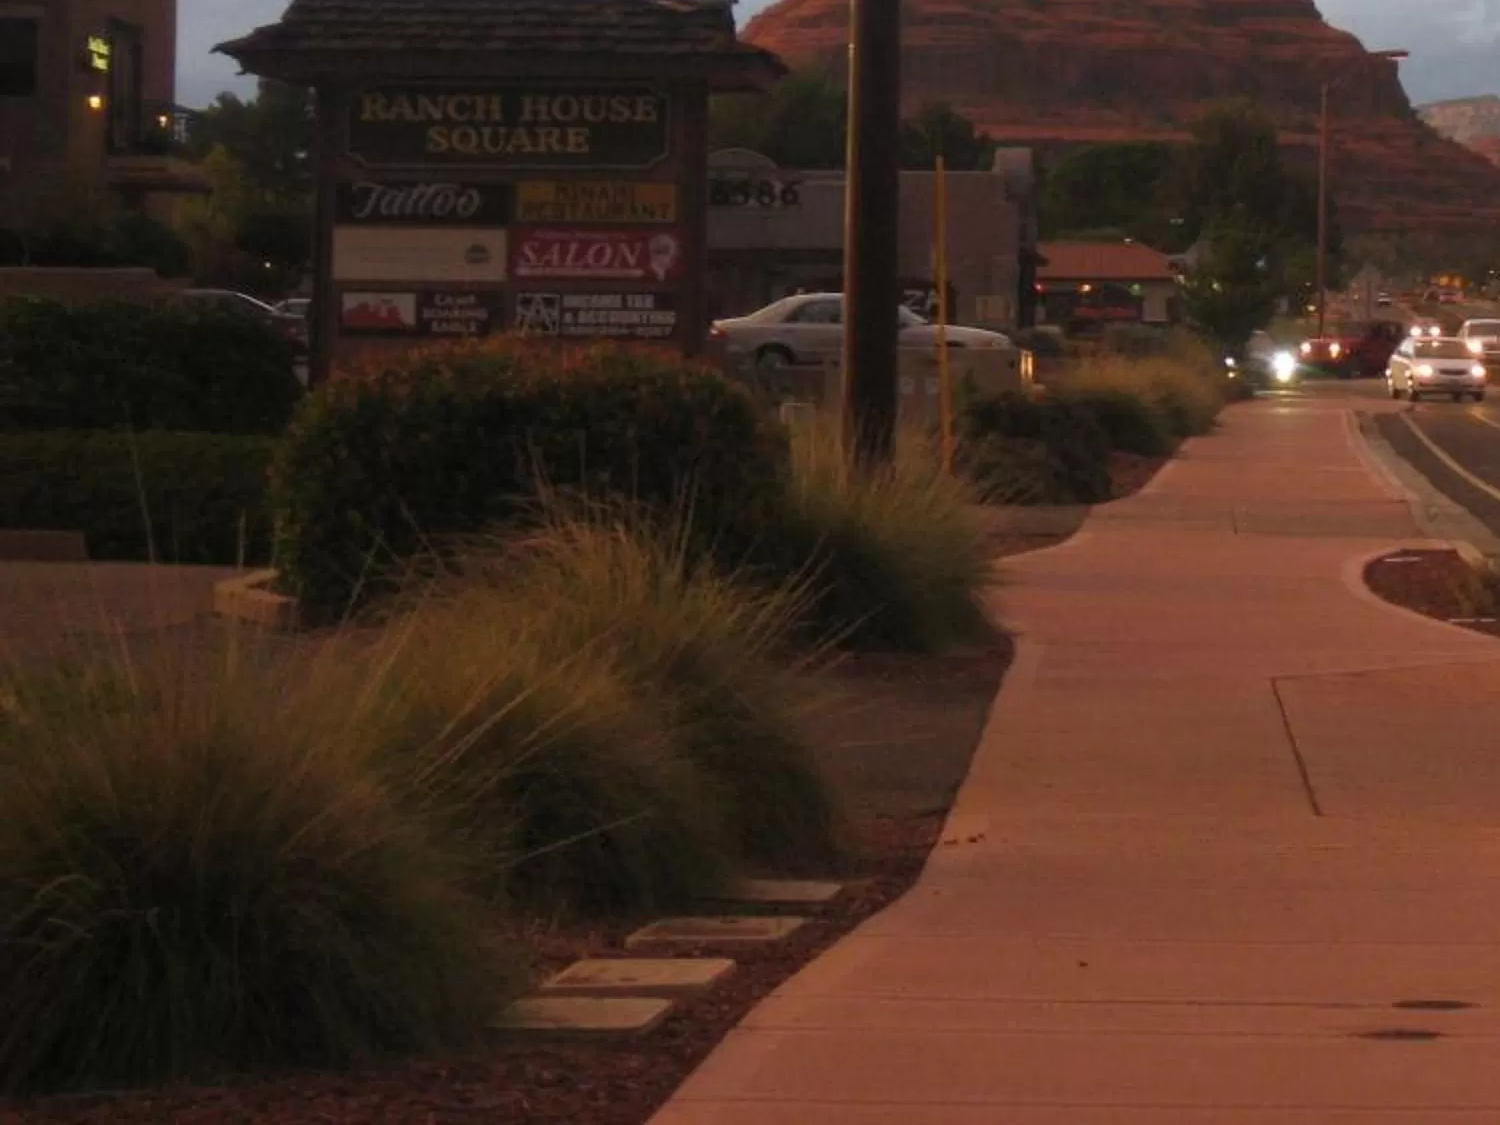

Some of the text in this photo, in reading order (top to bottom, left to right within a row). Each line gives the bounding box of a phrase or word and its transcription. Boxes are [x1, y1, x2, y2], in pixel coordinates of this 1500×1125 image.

[359, 91, 658, 123] RANCH HOUSE
[425, 125, 590, 155] SQUARE
[352, 180, 482, 219] Tattoo
[519, 240, 645, 268] SALON
